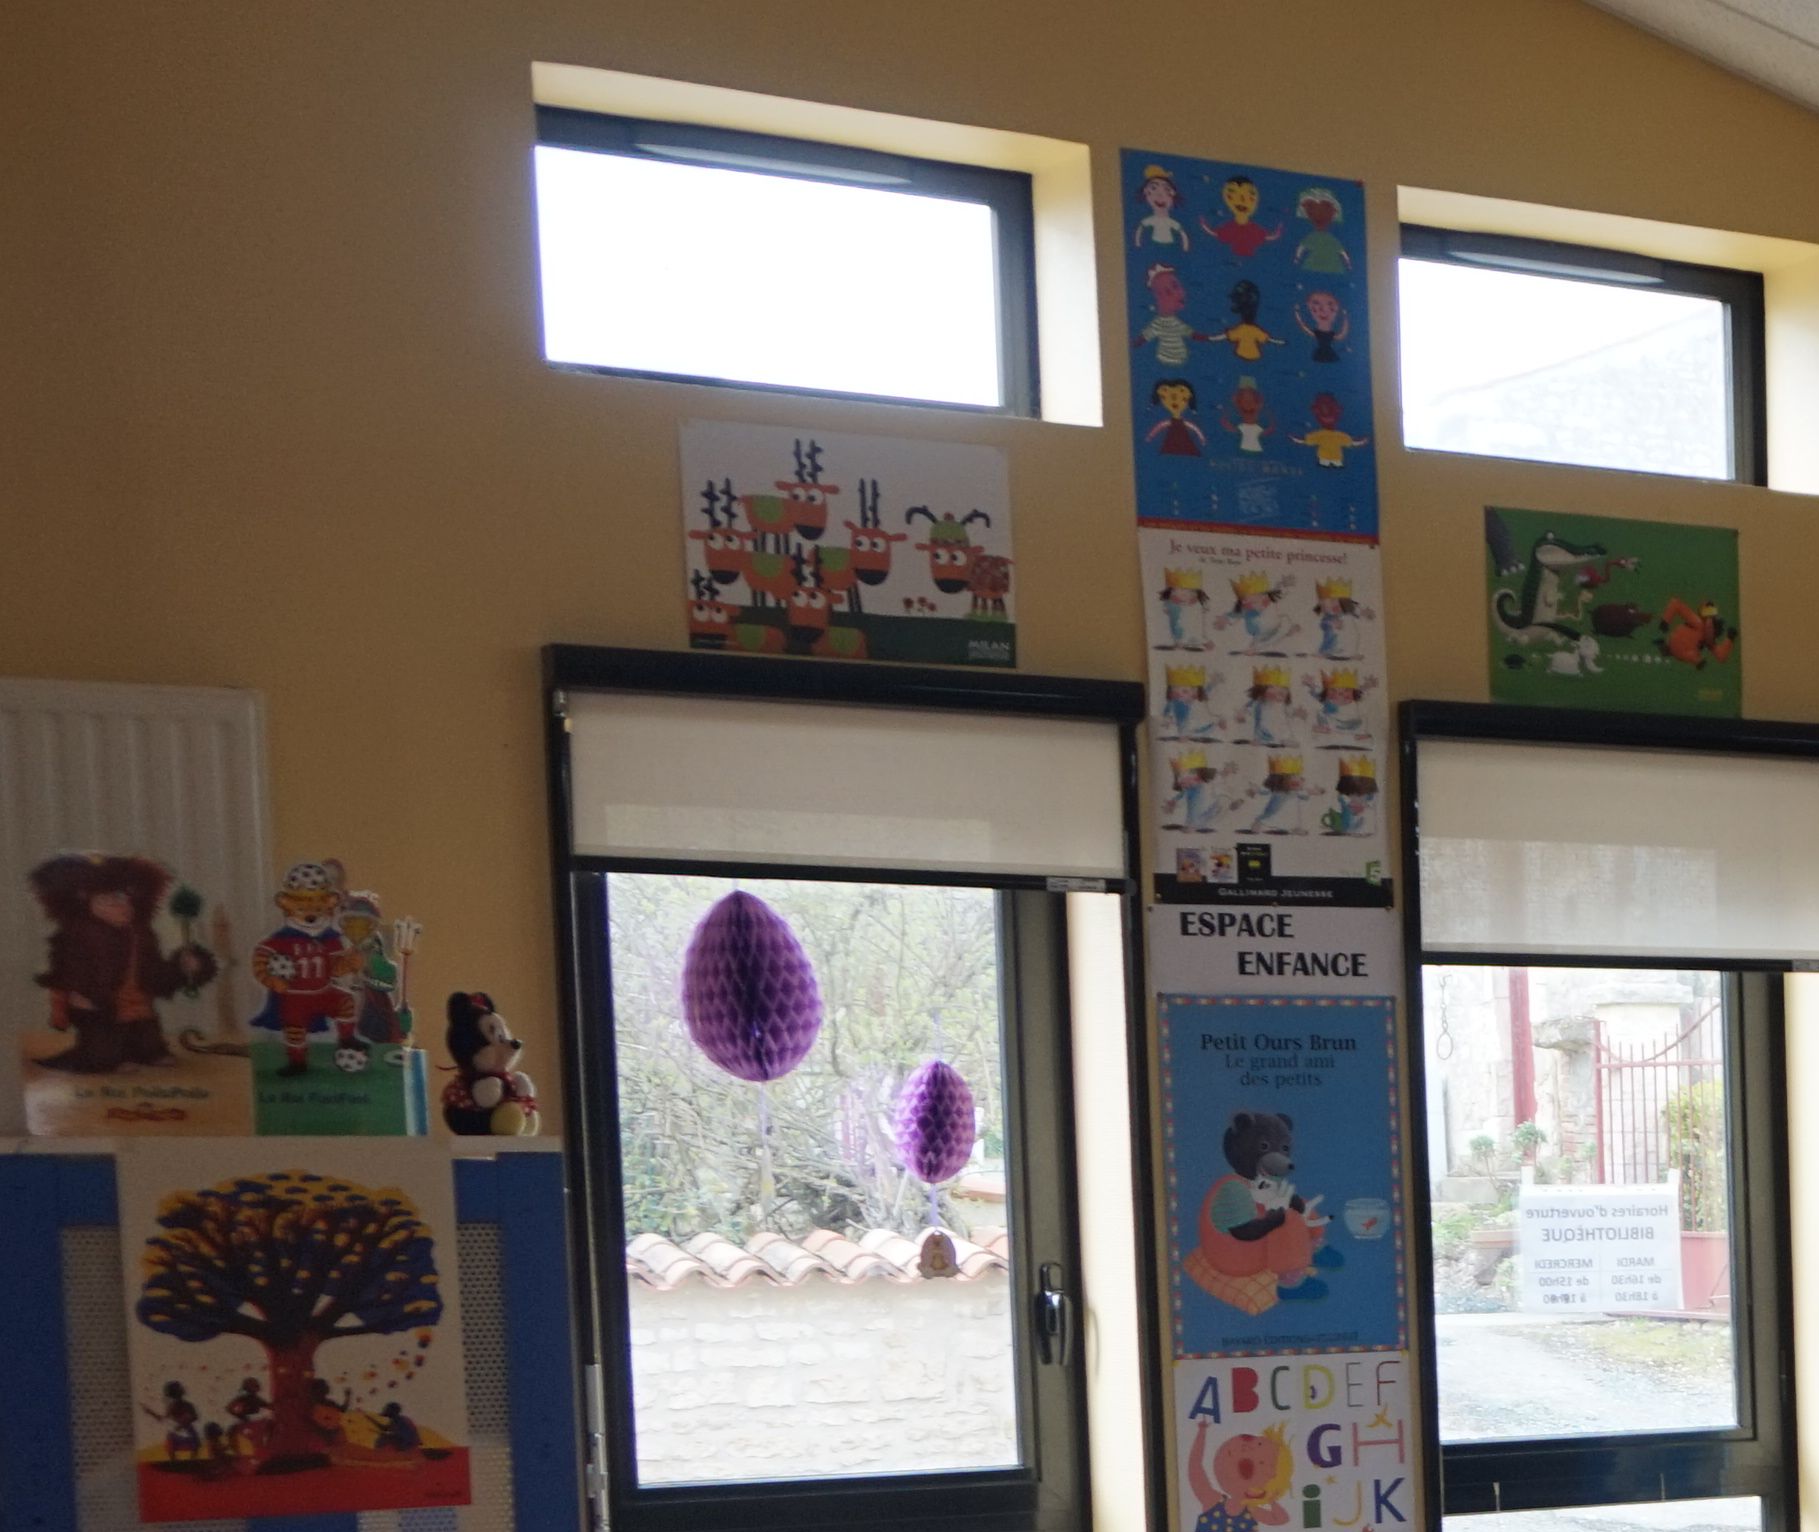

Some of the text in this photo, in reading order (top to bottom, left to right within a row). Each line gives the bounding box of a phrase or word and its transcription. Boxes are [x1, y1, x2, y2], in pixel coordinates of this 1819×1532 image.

[1170, 540, 1182, 555] Je
[1186, 543, 1217, 556] veux
[1222, 545, 1241, 557] ma
[1246, 546, 1282, 561] petite
[1217, 887, 1333, 898] GALLIMARD JEUNESSE
[1179, 911, 1295, 938] ESPACE
[1237, 951, 1369, 977] ENFANCE
[1200, 1033, 1357, 1051] Petit Ours Brun
[1225, 1053, 1246, 1068] Le
[1250, 1053, 1298, 1071] grand
[1240, 1071, 1322, 1089] des petits
